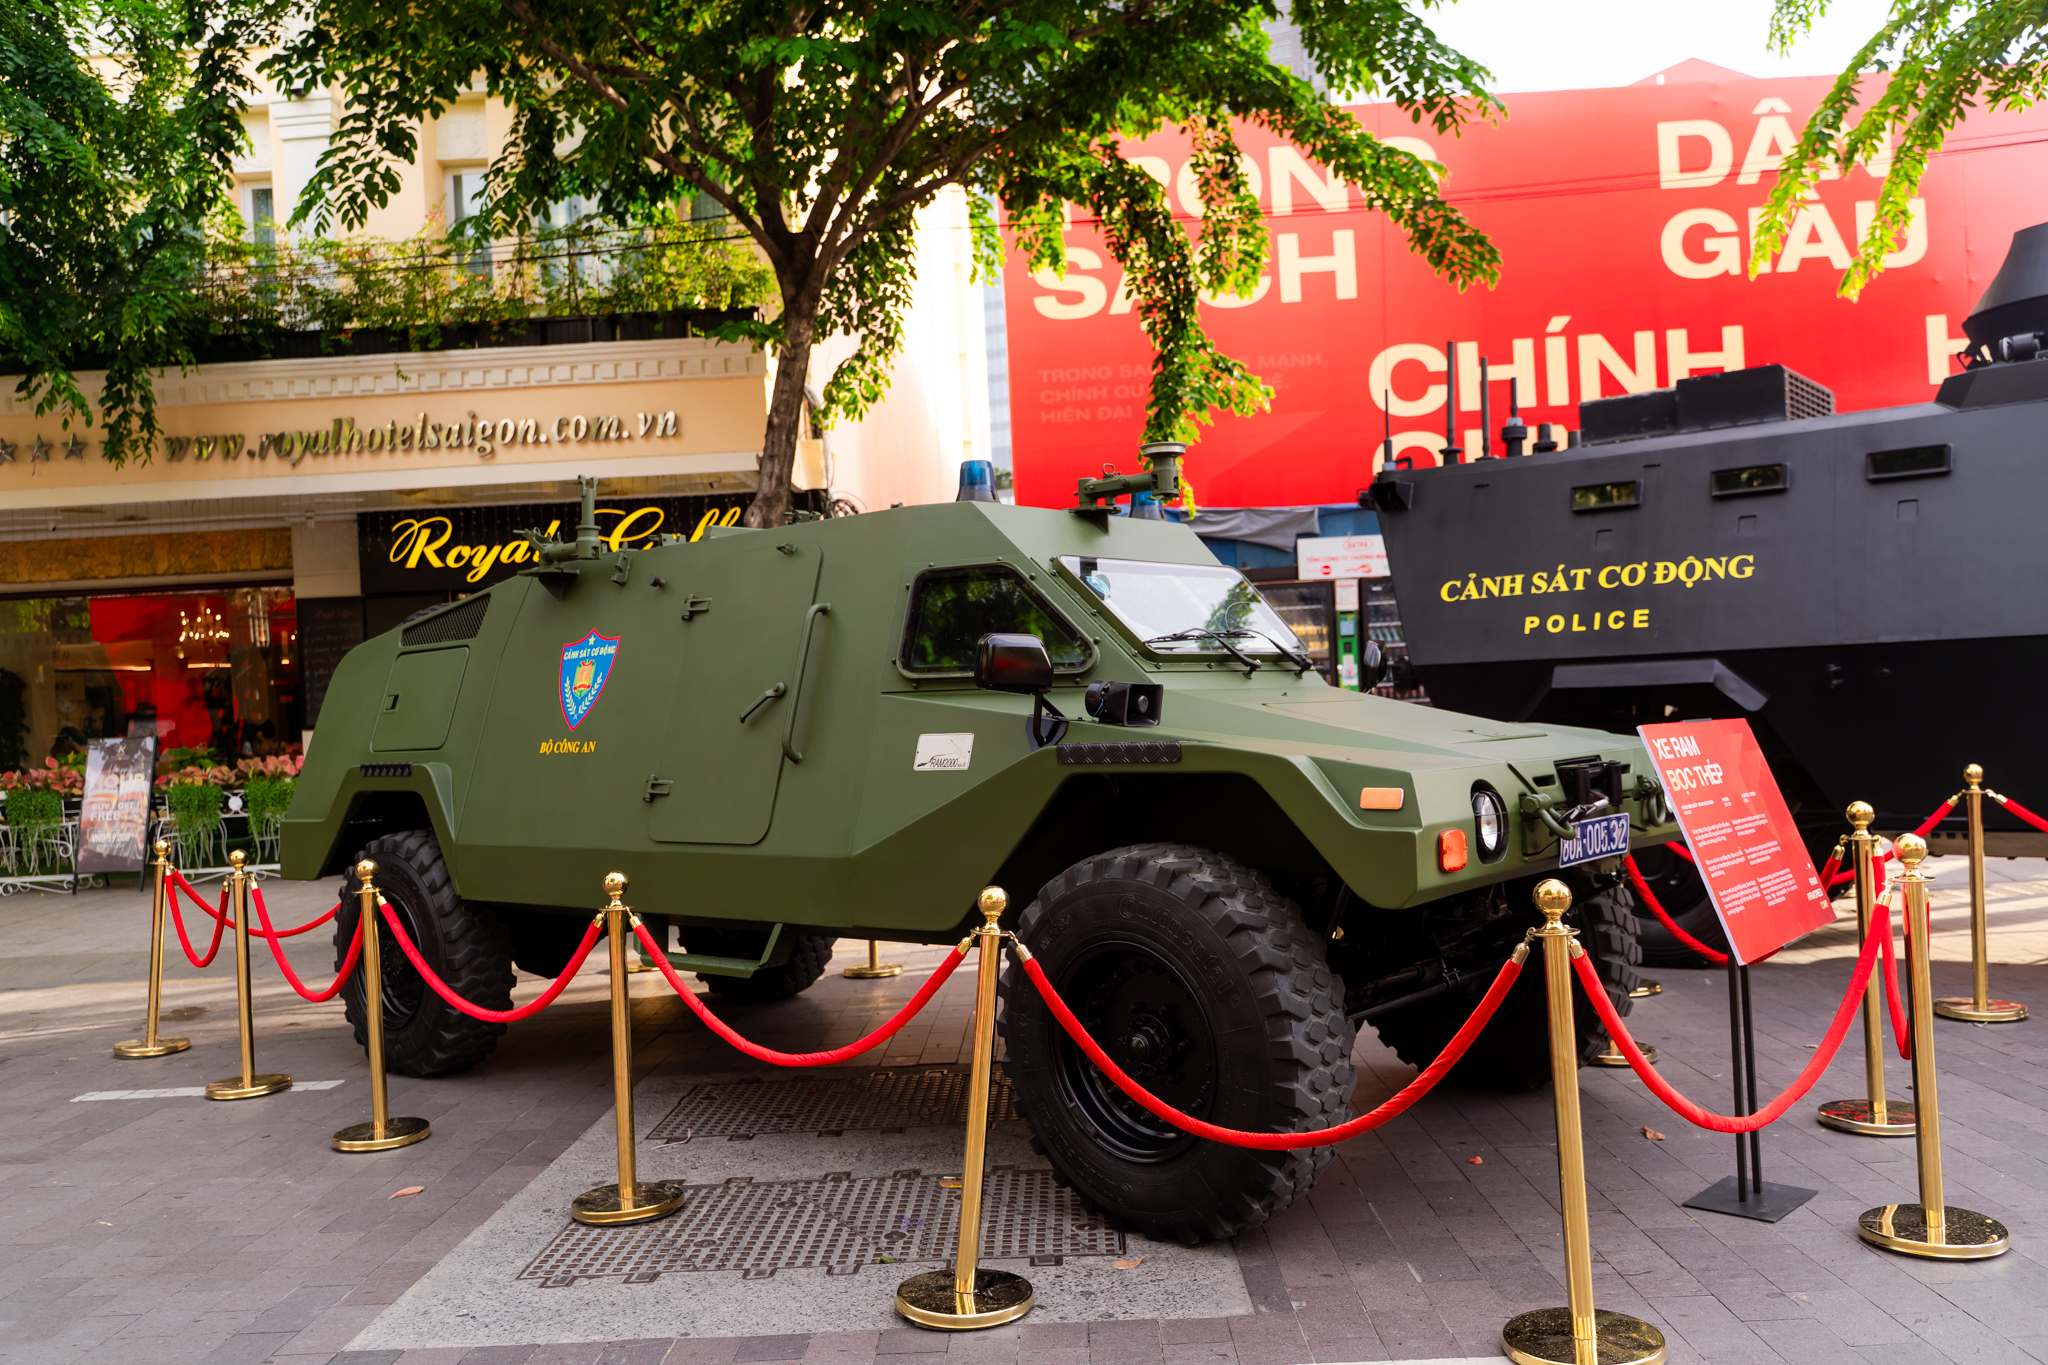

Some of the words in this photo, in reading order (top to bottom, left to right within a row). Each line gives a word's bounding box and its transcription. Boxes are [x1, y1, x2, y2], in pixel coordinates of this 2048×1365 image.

[1039, 365, 1113, 384] TRONG
[1369, 316, 1746, 417] CHÍNH
[1040, 383, 1108, 404] CHÍNH
[1041, 405, 1091, 425] HIỆN
[1097, 404, 1132, 421] ĐẠI
[1440, 573, 1525, 602] CẢNH
[1531, 564, 1591, 595] SÁT
[1598, 561, 1648, 589] CƠ
[1652, 555, 1755, 588] ĐỘNG
[1524, 609, 1650, 634] POLICE
[564, 649, 579, 660] CẢNH
[579, 648, 591, 658] SÁT
[591, 646, 600, 657] CƠ
[600, 644, 616, 656] ĐỘNG
[539, 739, 554, 755] BỘ
[554, 739, 580, 753] CÔNG
[580, 741, 597, 753] AN
[1652, 737, 1675, 760] XE
[1669, 735, 1702, 758] RAM
[1666, 767, 1697, 795] BỌC
[1692, 759, 1724, 787] THÉP
[90, 810, 121, 821] FREE
[1563, 819, 1627, 862] 80A-005.32
